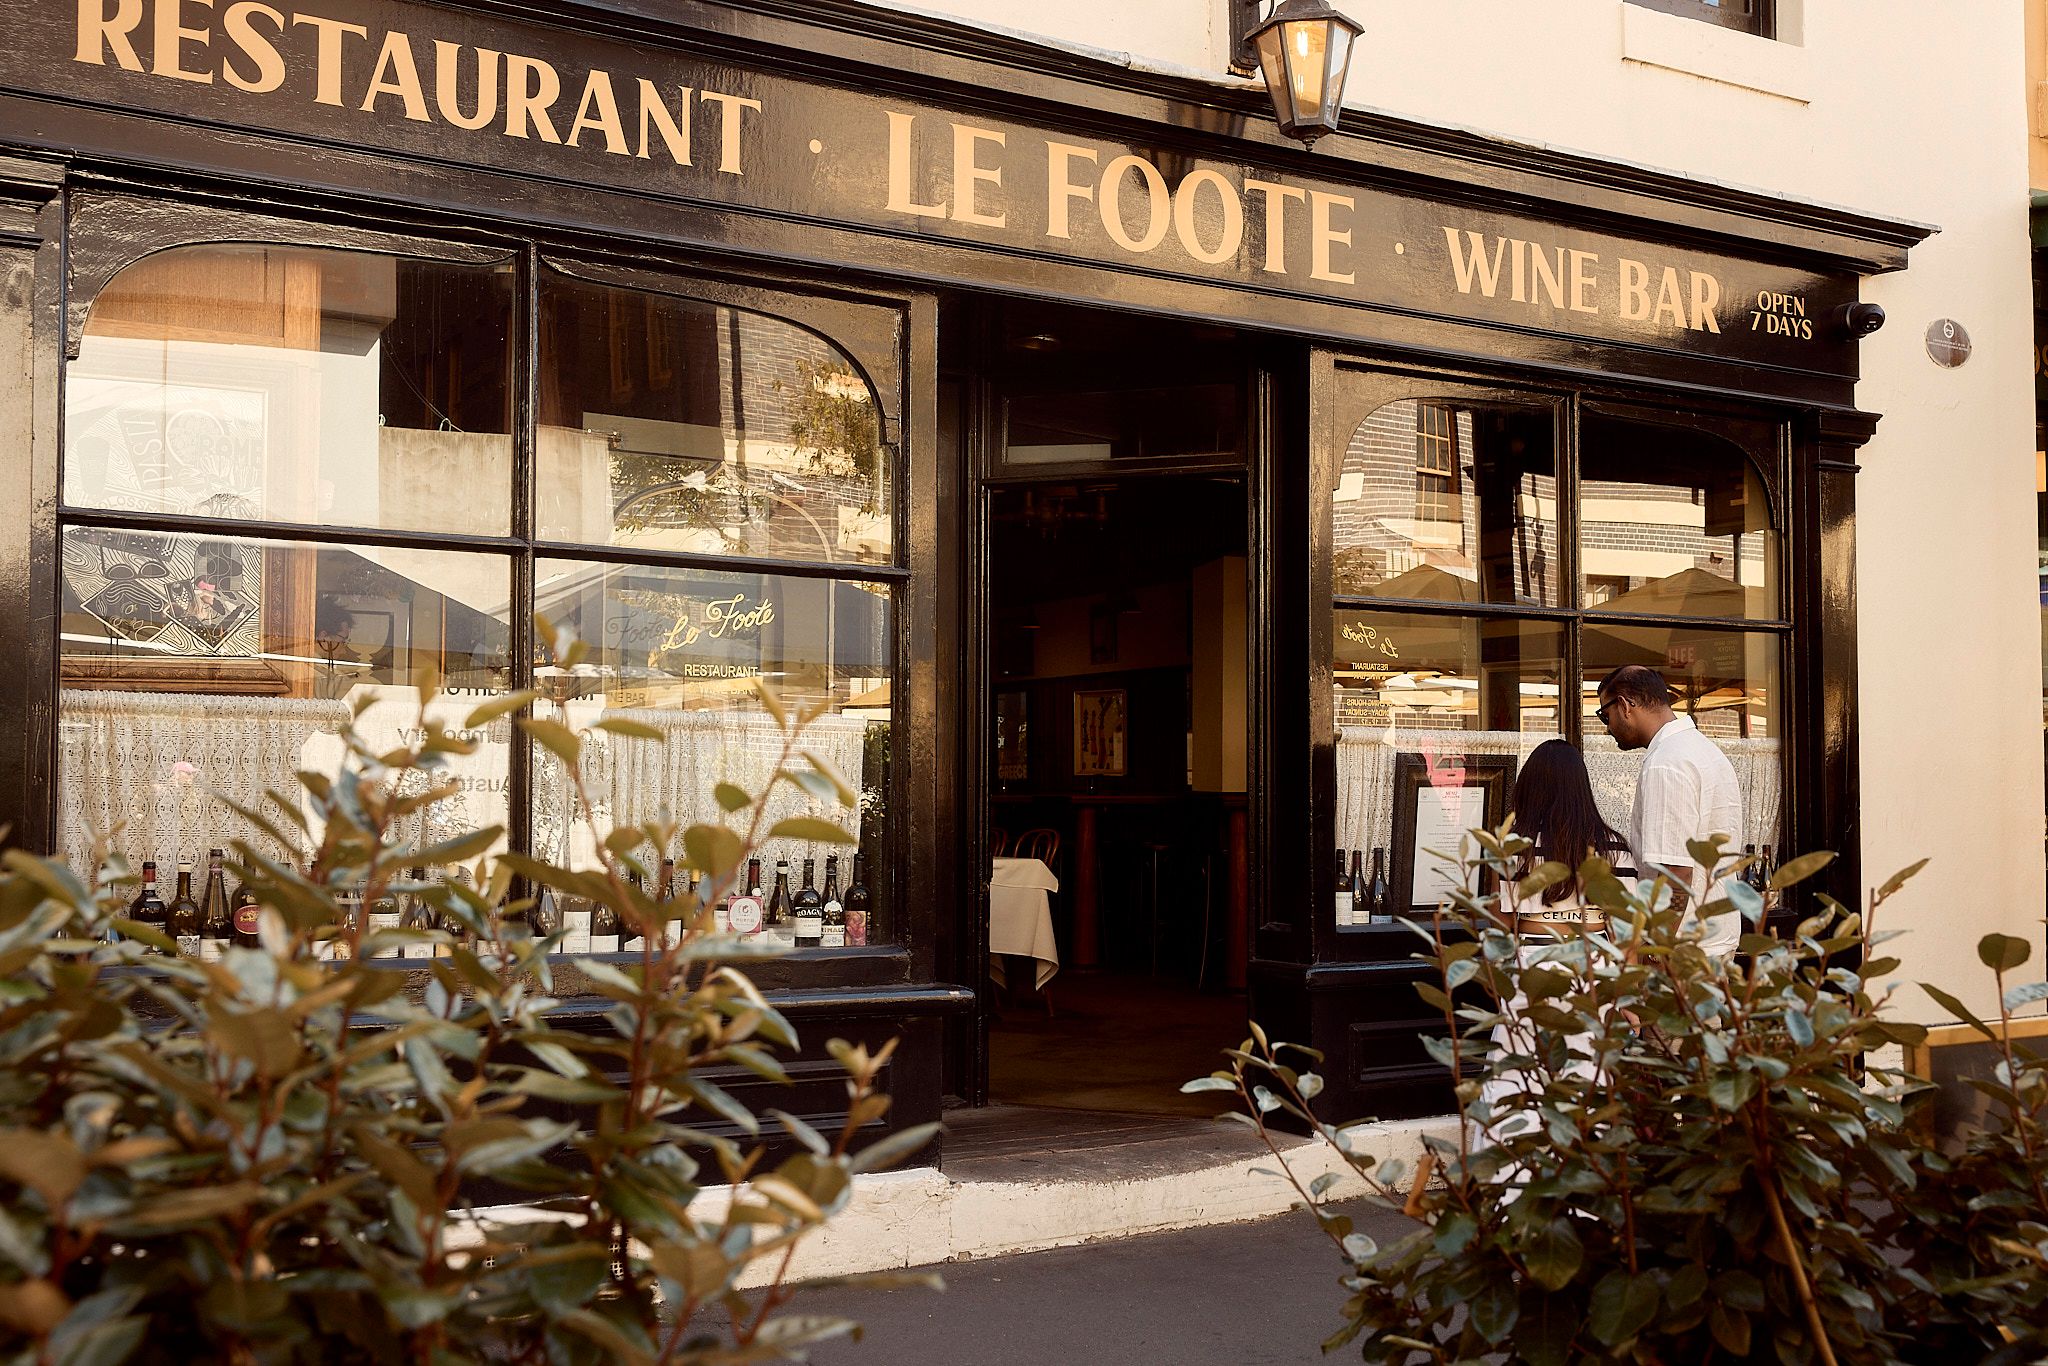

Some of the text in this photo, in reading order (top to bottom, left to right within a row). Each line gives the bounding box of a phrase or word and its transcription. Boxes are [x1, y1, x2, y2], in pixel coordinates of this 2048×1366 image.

[73, 0, 1723, 335] RESTAURANT LE FOOTE WINE BAR
[1757, 291, 1805, 317] OPEN
[1750, 311, 1812, 340] 7 DAYS
[660, 593, 775, 652] Le Foote
[684, 663, 759, 678] RESTAURANT
